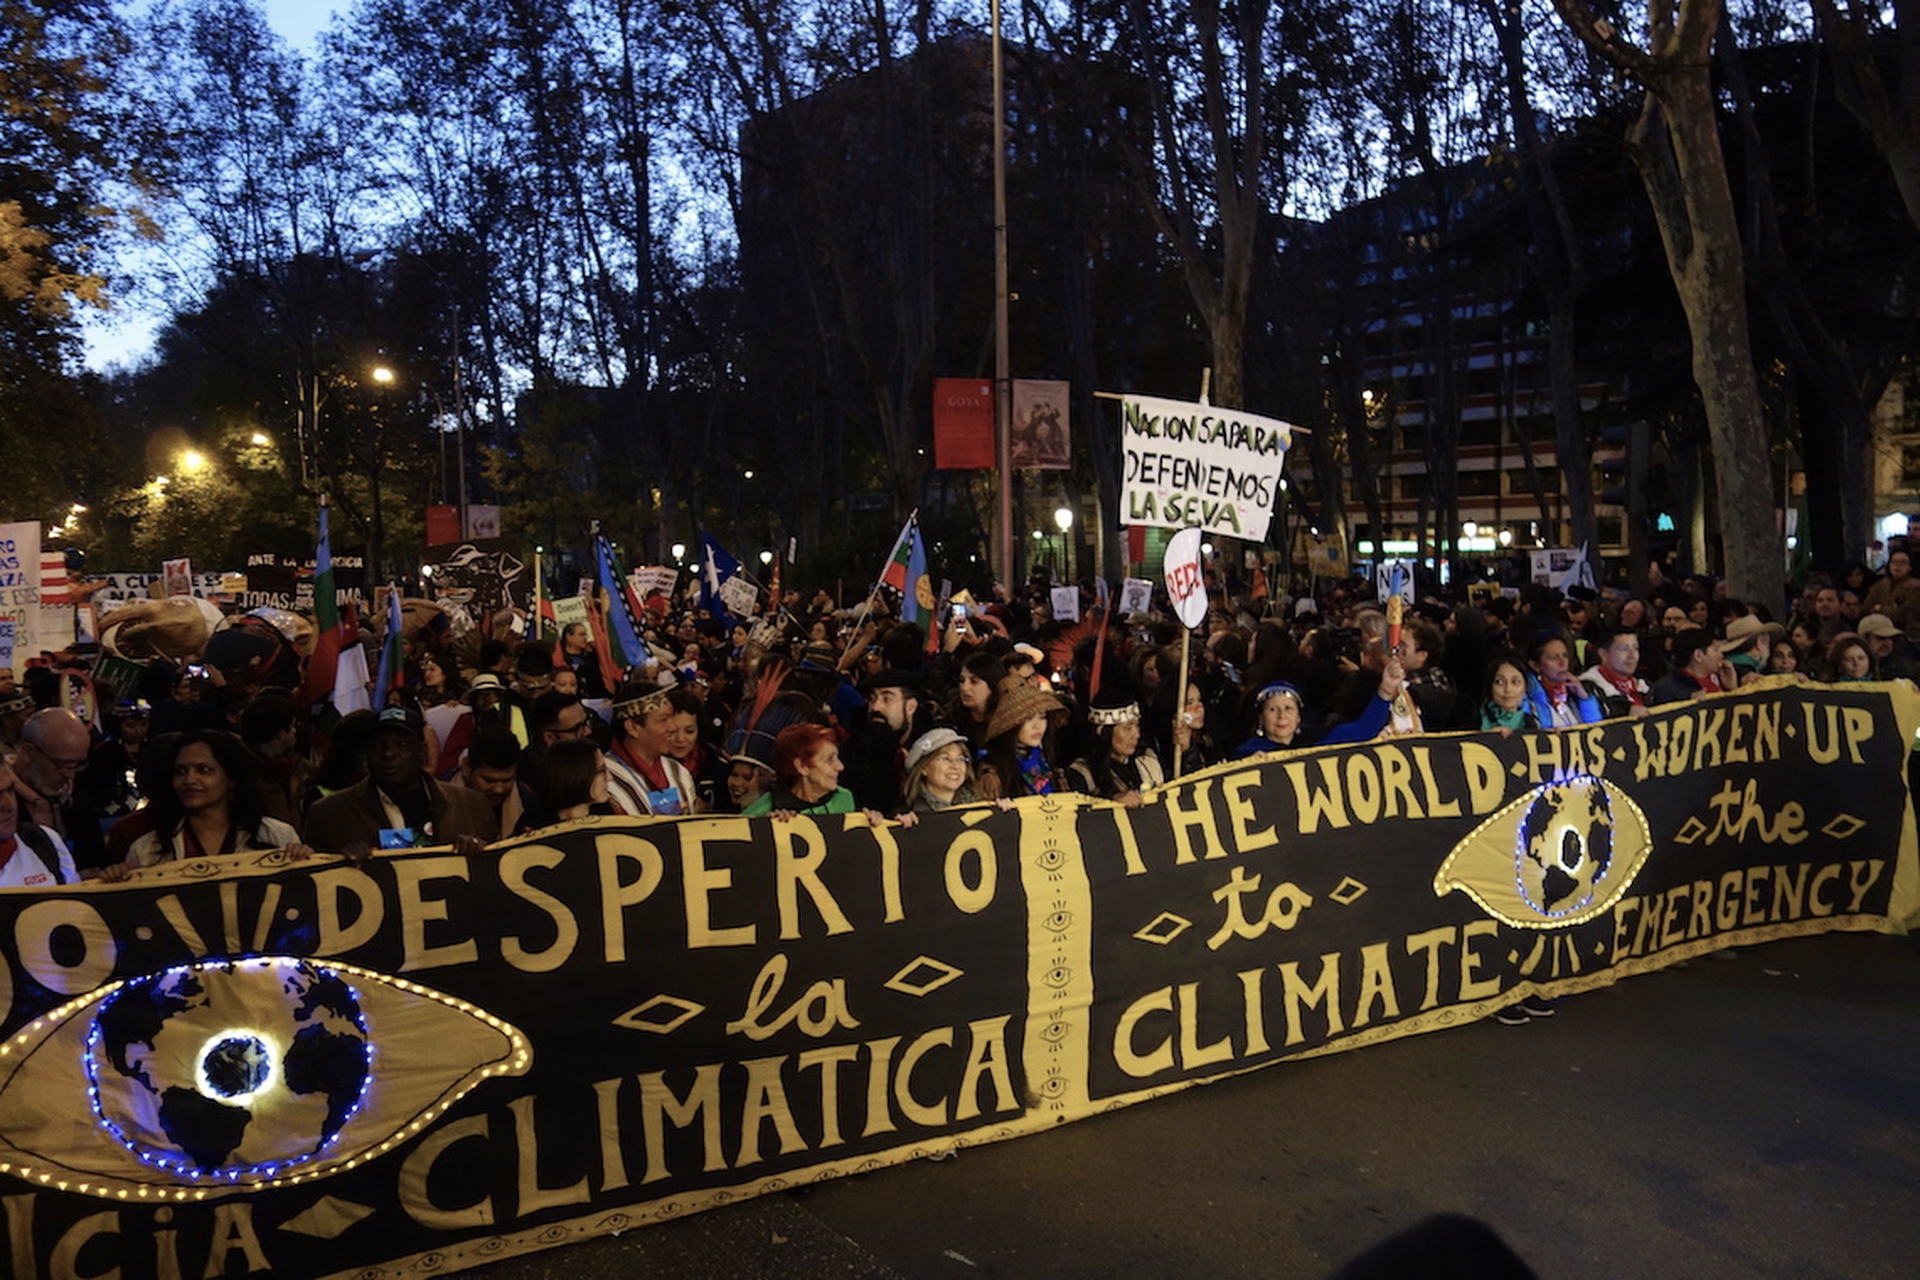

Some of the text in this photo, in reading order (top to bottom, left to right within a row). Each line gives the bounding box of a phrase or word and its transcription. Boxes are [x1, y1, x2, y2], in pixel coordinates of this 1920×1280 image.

[947, 396, 981, 407] GOYA
[1130, 490, 1241, 534] LA SEVA
[247, 554, 275, 566] ANTE
[242, 591, 290, 609] TODAS
[1092, 702, 1875, 876] THE WORLD HAS WOKEN UP
[1705, 778, 1809, 847] the
[1206, 866, 1313, 951] to
[726, 953, 861, 1041] la
[1113, 860, 1885, 1078] CLIMATE EMERGENCY
[399, 1014, 1021, 1231] CLIMATICA
